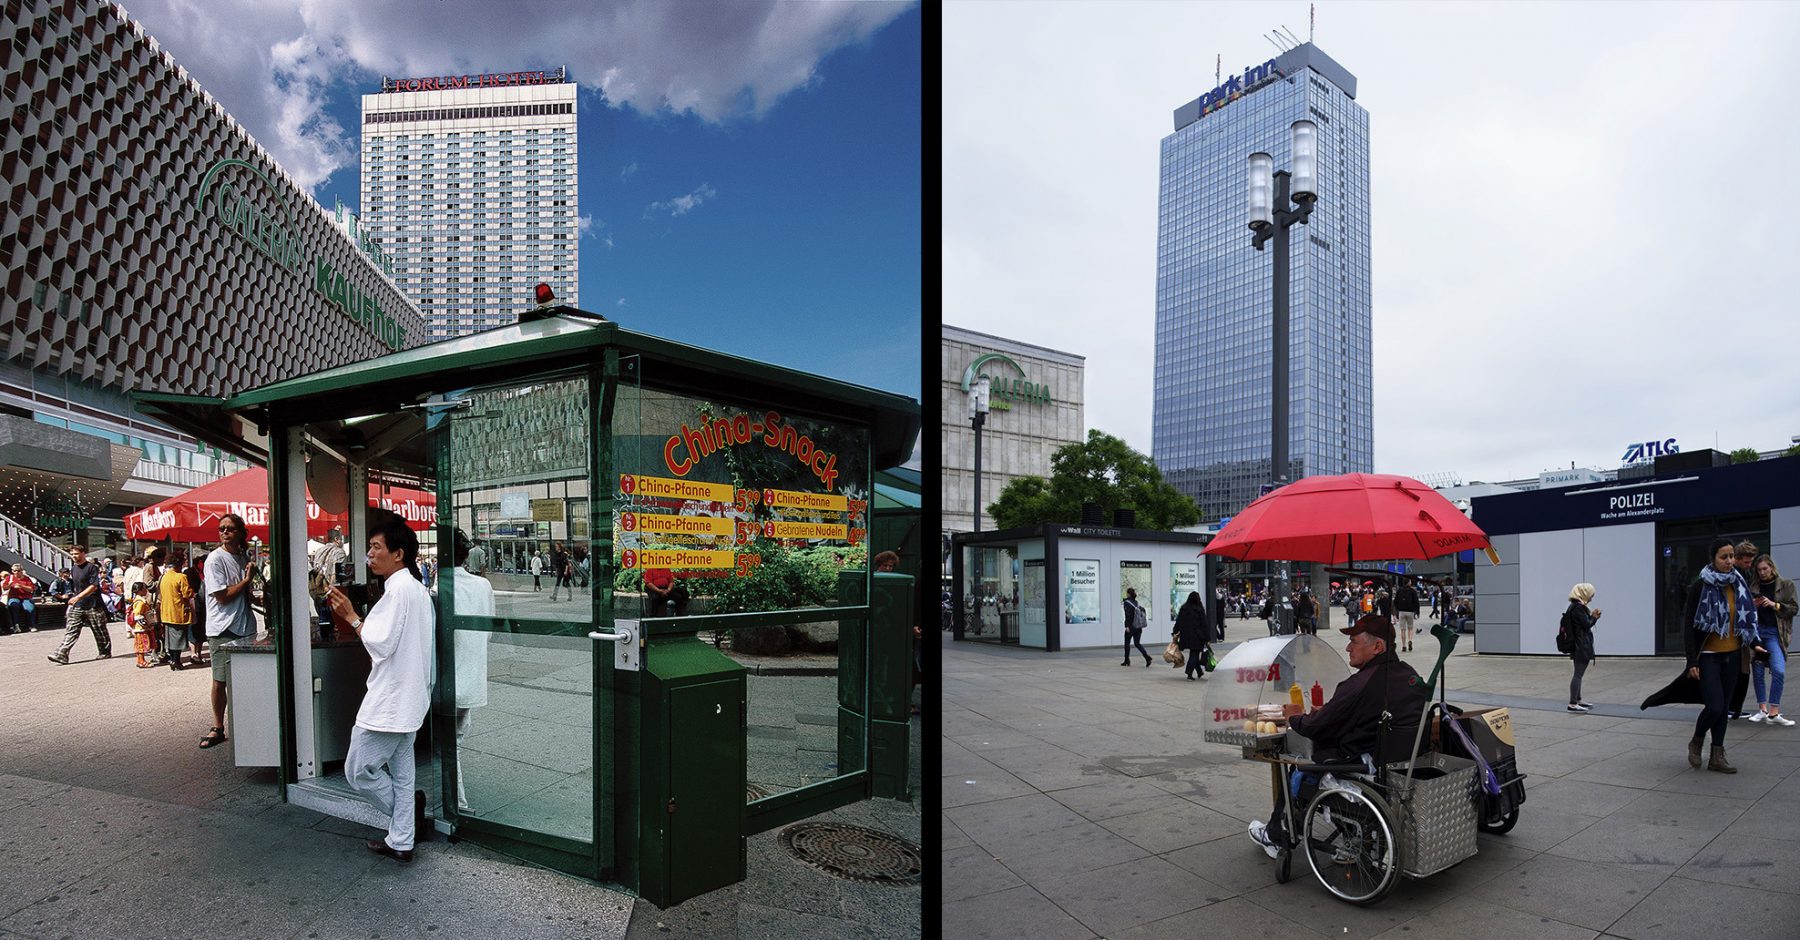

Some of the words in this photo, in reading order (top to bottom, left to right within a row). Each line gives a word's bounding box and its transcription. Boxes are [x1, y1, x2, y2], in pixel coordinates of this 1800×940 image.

[395, 75, 468, 92] FORUM
[479, 71, 549, 88] HOTEL
[1199, 75, 1241, 117] park
[1244, 58, 1276, 87] inn
[218, 183, 300, 276] GALERIA
[980, 373, 1052, 408] ALERIA
[664, 410, 839, 492] China-Snack
[1545, 474, 1580, 484] PRIMARK
[638, 478, 711, 498] China-Pfanne
[776, 492, 830, 508] China-Pfanne
[1610, 492, 1655, 509] POLIZEI
[142, 506, 176, 533] Marlboro
[1626, 507, 1664, 517] Alexanderplatz
[640, 516, 712, 532] China-Pfanne
[776, 523, 815, 536] Gebratene
[815, 526, 843, 537] Nudeln
[1097, 528, 1121, 537] TOILETTE
[640, 553, 712, 566] China-Pfanne
[1353, 561, 1413, 573] PRIMK
[1071, 577, 1096, 585] Besucher
